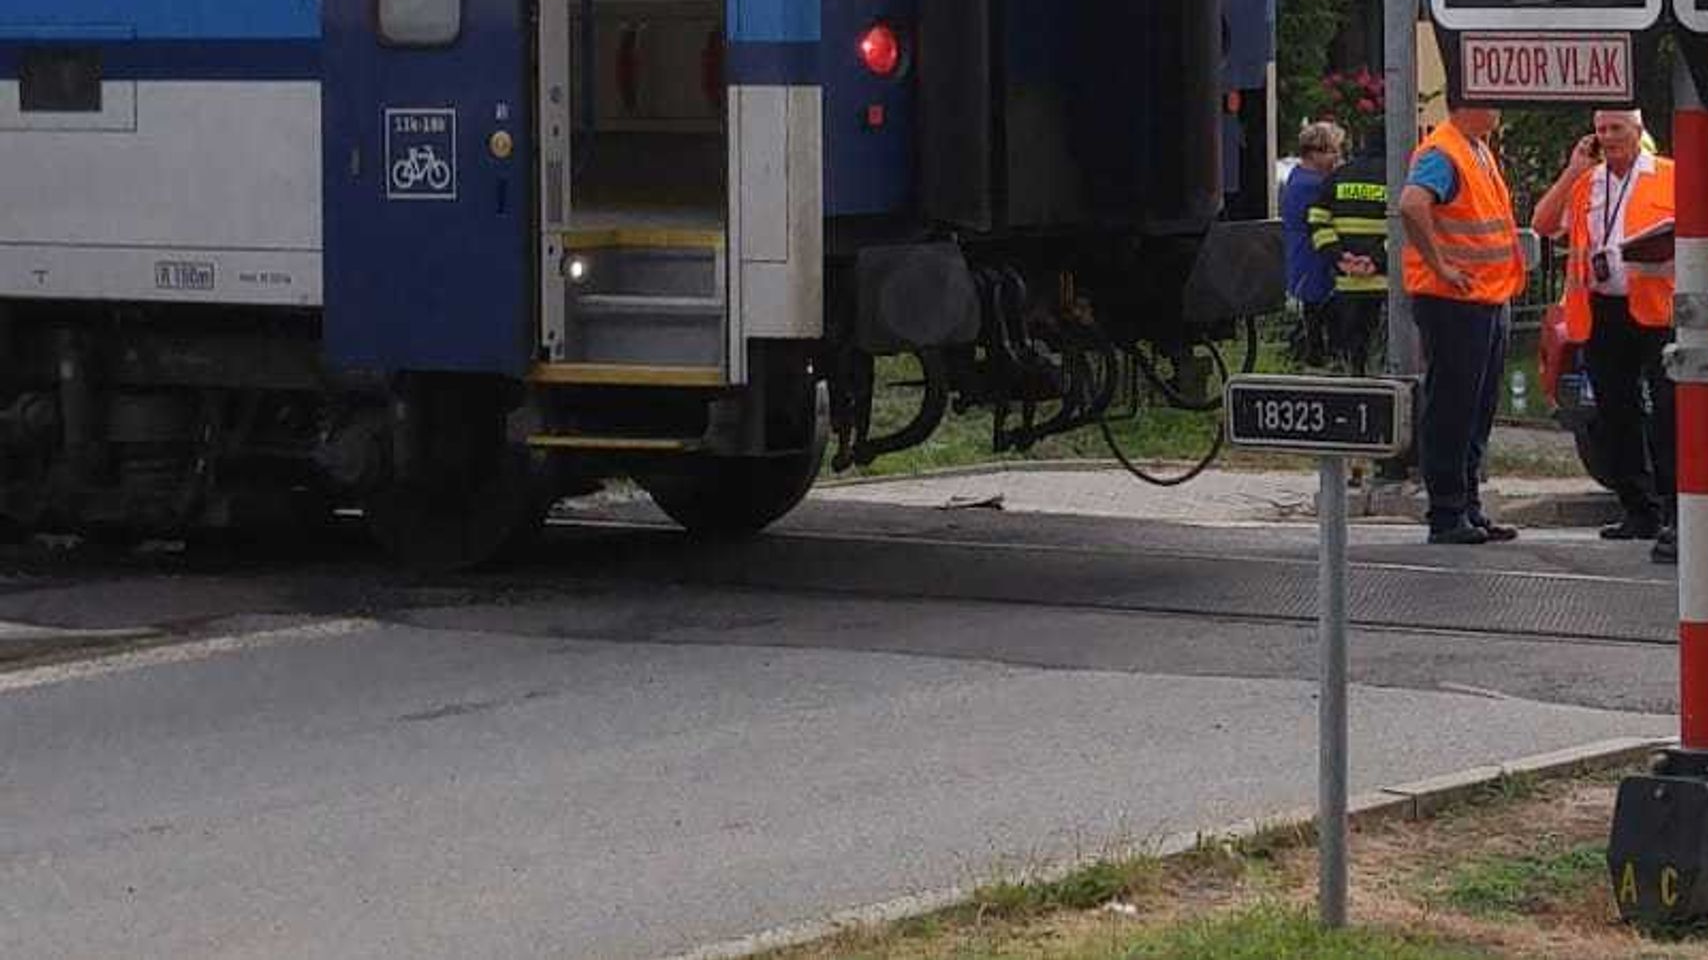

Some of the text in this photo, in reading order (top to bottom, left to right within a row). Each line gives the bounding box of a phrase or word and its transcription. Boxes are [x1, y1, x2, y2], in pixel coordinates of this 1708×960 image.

[1472, 46, 1621, 87] POZOR VLAK
[1255, 400, 1325, 432] 18323
[1358, 403, 1368, 433] 1
[1620, 862, 1678, 906] A C
